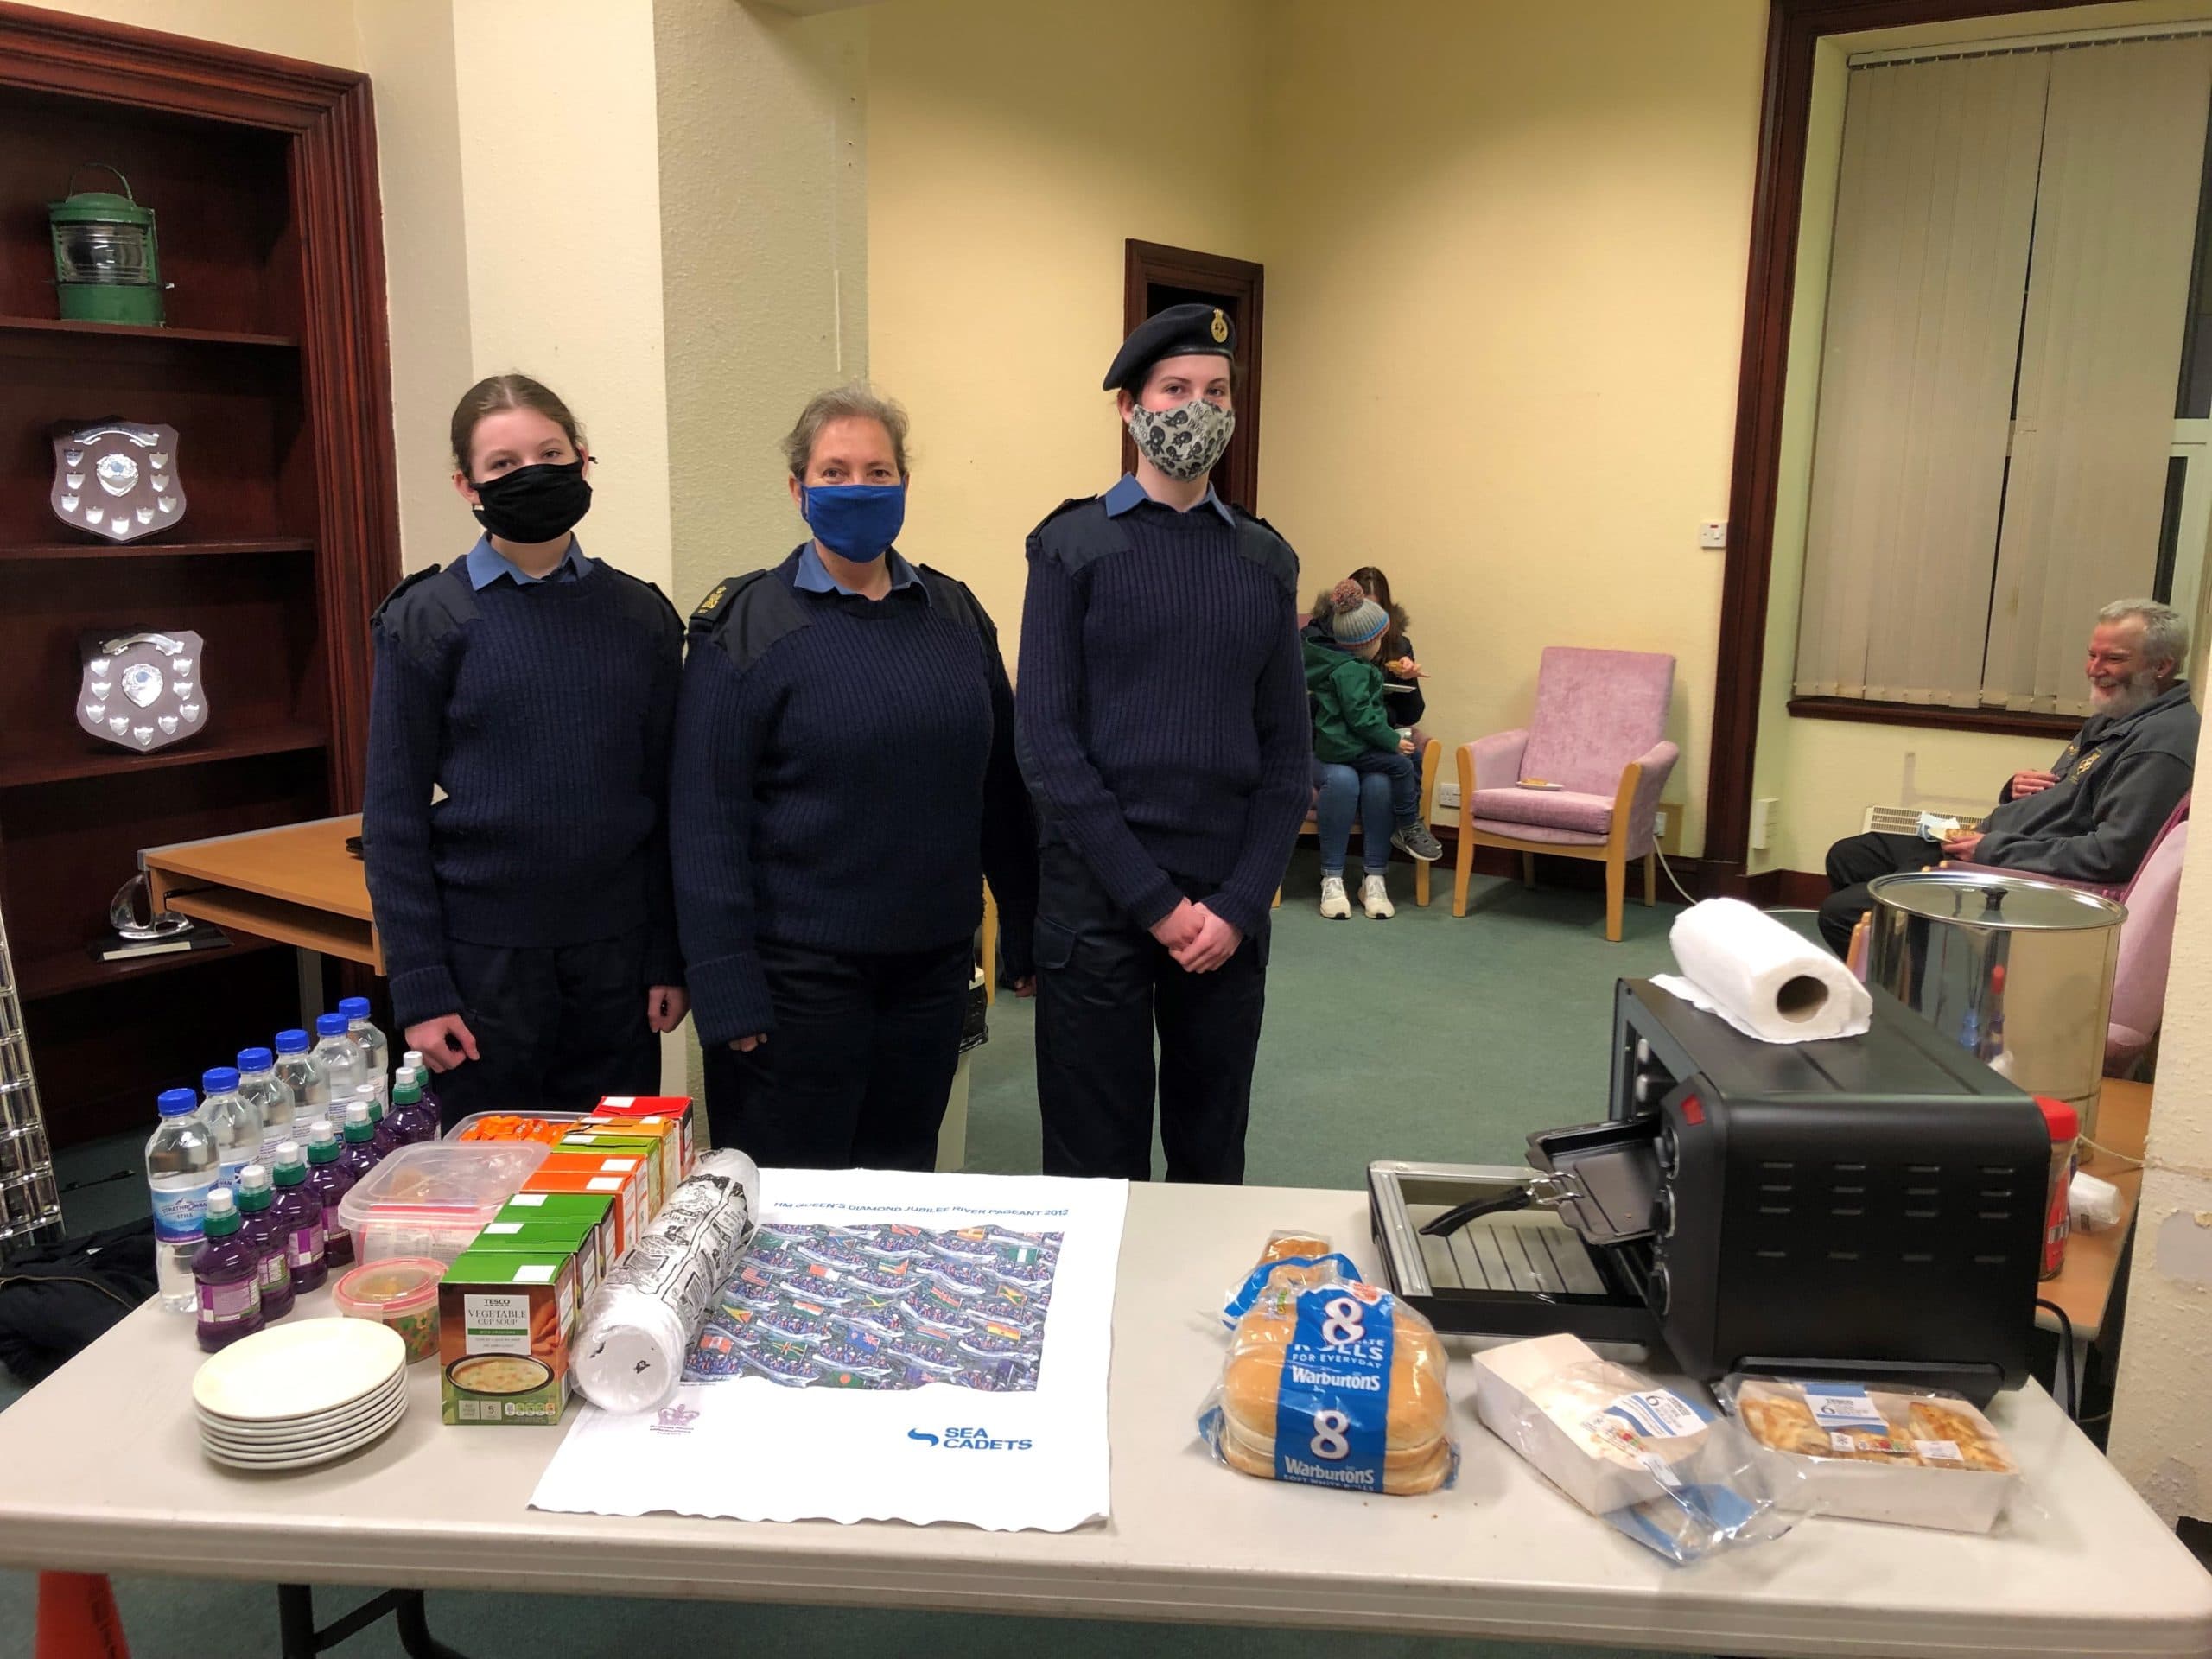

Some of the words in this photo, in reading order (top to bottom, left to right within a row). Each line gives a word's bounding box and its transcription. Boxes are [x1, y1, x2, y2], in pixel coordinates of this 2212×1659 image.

[467, 1309, 526, 1319] VEGETABLE
[1322, 1297, 1365, 1346] 8
[1292, 1353, 1315, 1363] FOR
[1320, 1354, 1382, 1369] EVERYDAY
[487, 1405, 494, 1414] 5
[944, 1427, 988, 1439] SEA
[1310, 1410, 1350, 1459] 8
[944, 1439, 1033, 1451] CADETS
